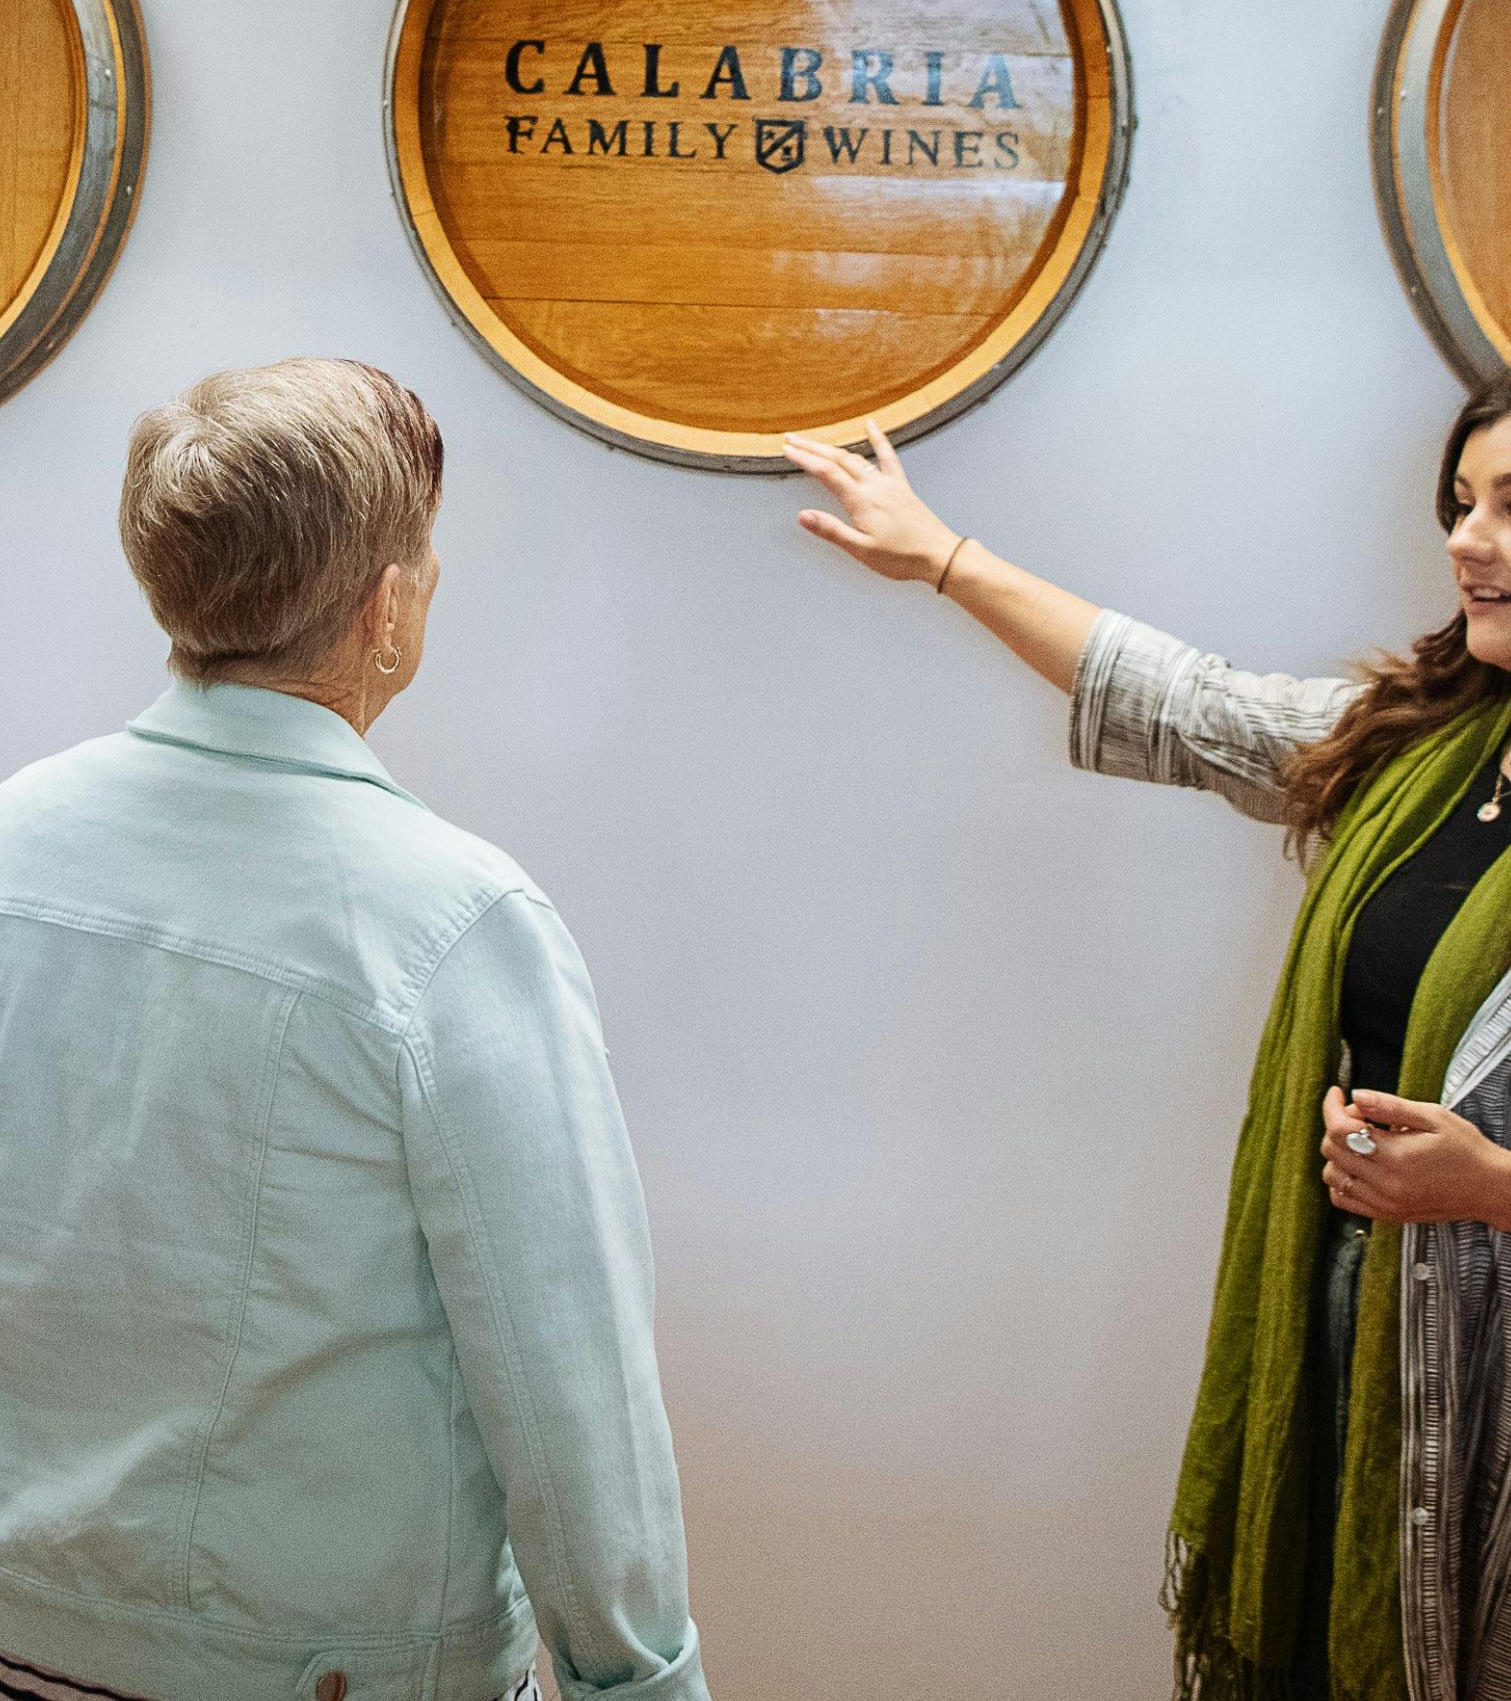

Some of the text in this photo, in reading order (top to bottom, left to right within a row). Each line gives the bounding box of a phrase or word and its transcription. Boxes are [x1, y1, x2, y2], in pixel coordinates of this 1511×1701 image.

[505, 38, 1021, 110] CALABRIA
[505, 115, 1020, 171] FAMILY WINES
